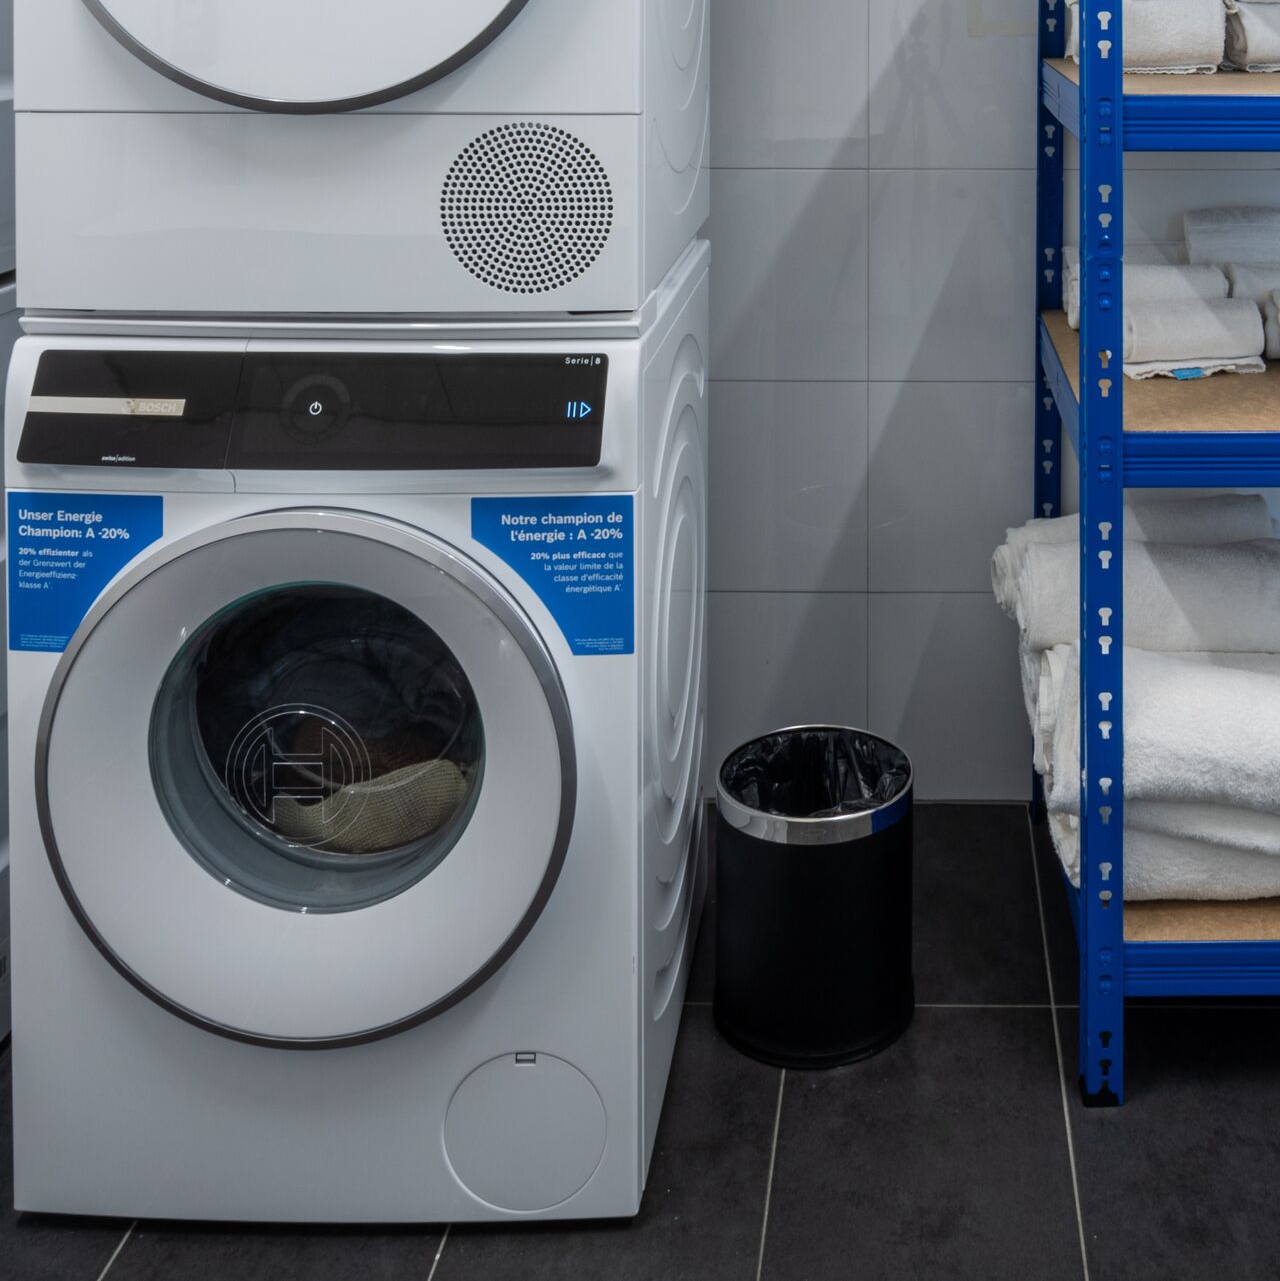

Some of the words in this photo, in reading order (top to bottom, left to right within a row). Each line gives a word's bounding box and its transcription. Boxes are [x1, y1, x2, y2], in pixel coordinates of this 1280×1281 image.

[138, 402, 177, 413] BOSCH
[18, 509, 54, 521] Unser
[57, 510, 103, 524] Energie
[501, 513, 537, 525] Notre
[541, 512, 603, 525] champion
[607, 512, 623, 523] de
[18, 525, 82, 539] Champion:
[85, 528, 95, 539] A
[98, 528, 130, 539] -20%
[577, 529, 587, 540] A
[590, 528, 623, 539] -20%
[18, 547, 37, 555] 20%
[38, 548, 79, 557] effizienter
[82, 549, 93, 558] als
[530, 552, 550, 560] 20%
[552, 551, 571, 561] plus
[573, 551, 606, 559] efficace
[608, 552, 624, 560] que
[18, 558, 31, 566] der
[32, 559, 71, 568] Grenzwert
[73, 560, 86, 568] der
[544, 563, 552, 571] la
[553, 563, 577, 571] valeur
[579, 562, 602, 570] limite
[603, 562, 614, 570] de
[616, 561, 624, 569] la
[18, 570, 78, 580] Energieeffizienz-
[553, 574, 579, 582] classe
[580, 573, 624, 582] d'efficacité
[18, 581, 42, 589] klasse
[565, 584, 612, 594] énergétique
